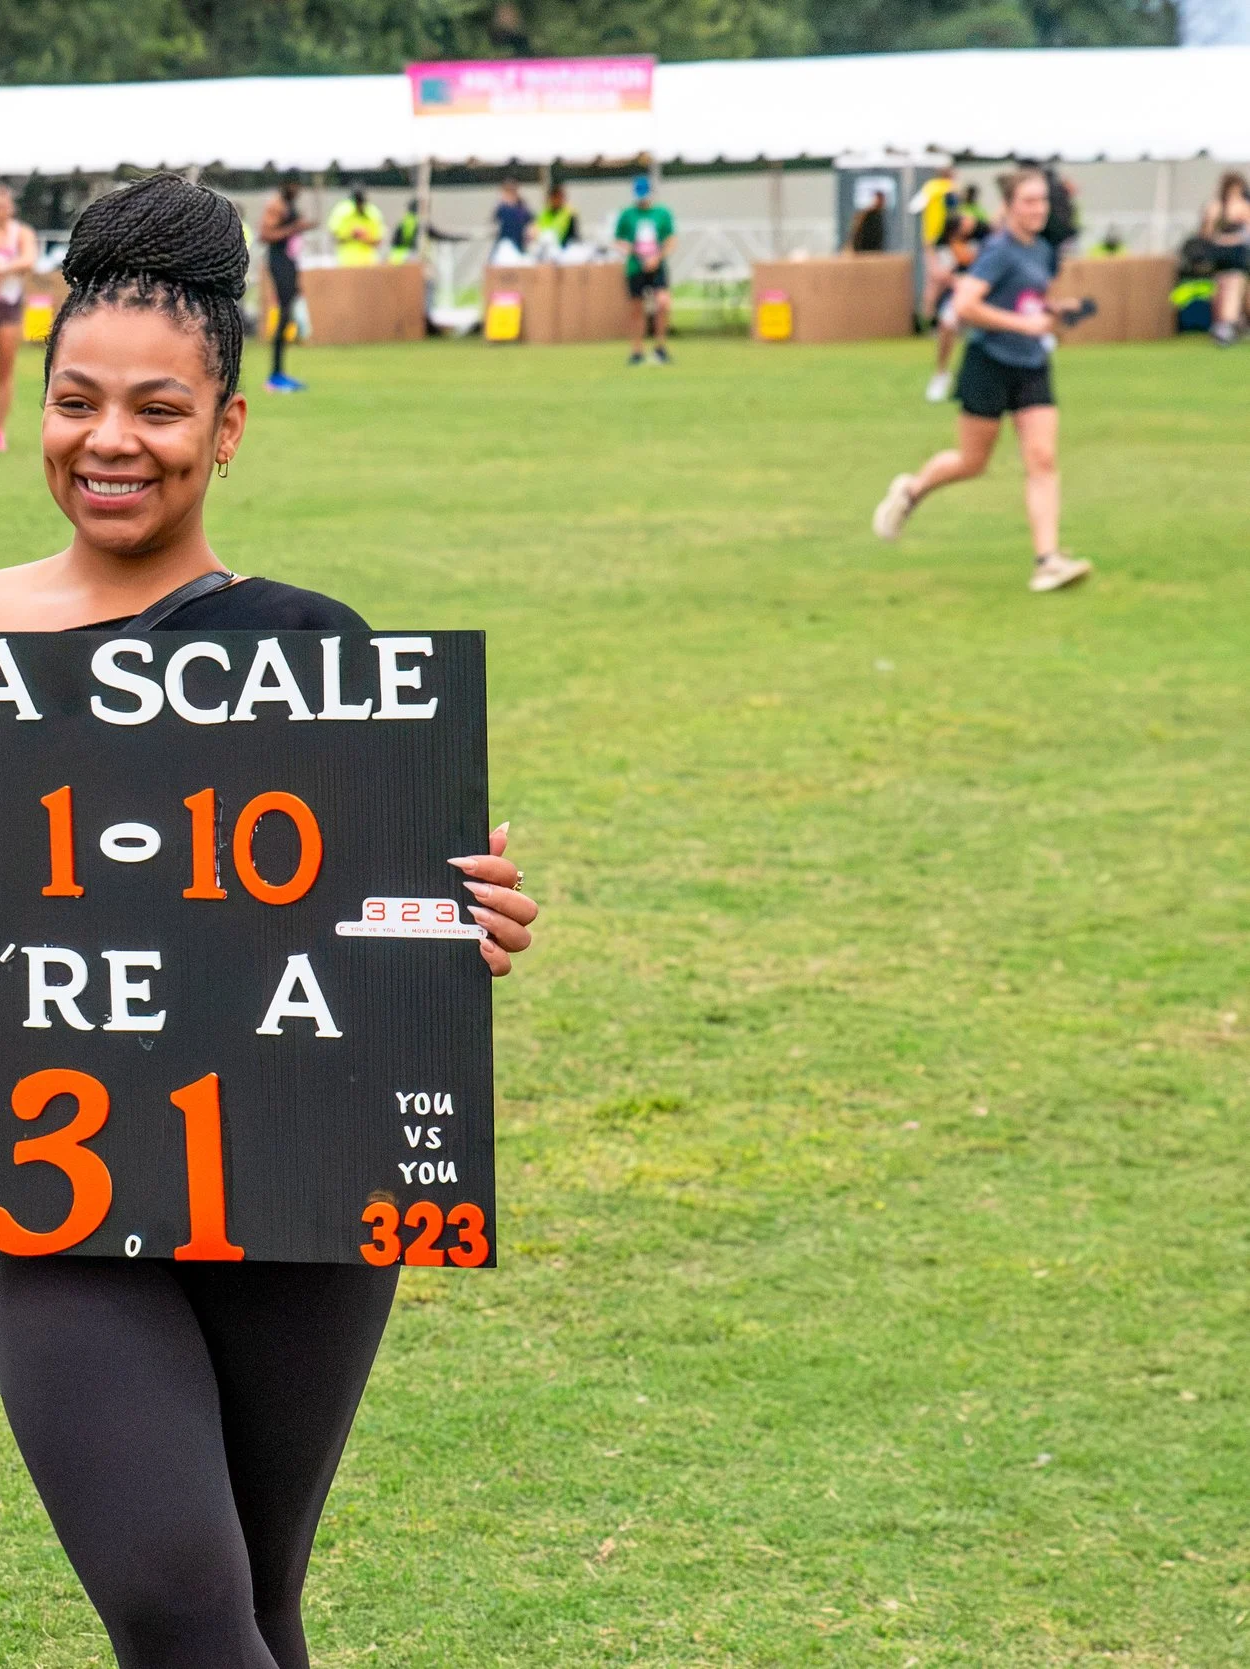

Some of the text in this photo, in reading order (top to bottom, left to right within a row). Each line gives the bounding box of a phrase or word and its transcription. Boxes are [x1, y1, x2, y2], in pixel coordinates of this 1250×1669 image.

[91, 636, 438, 726] SCALE
[255, 953, 343, 1038] A
[395, 1091, 454, 1116] YOU
[403, 1124, 442, 1150] VS
[398, 1160, 458, 1185] YOU
[359, 1200, 490, 1268] 323
